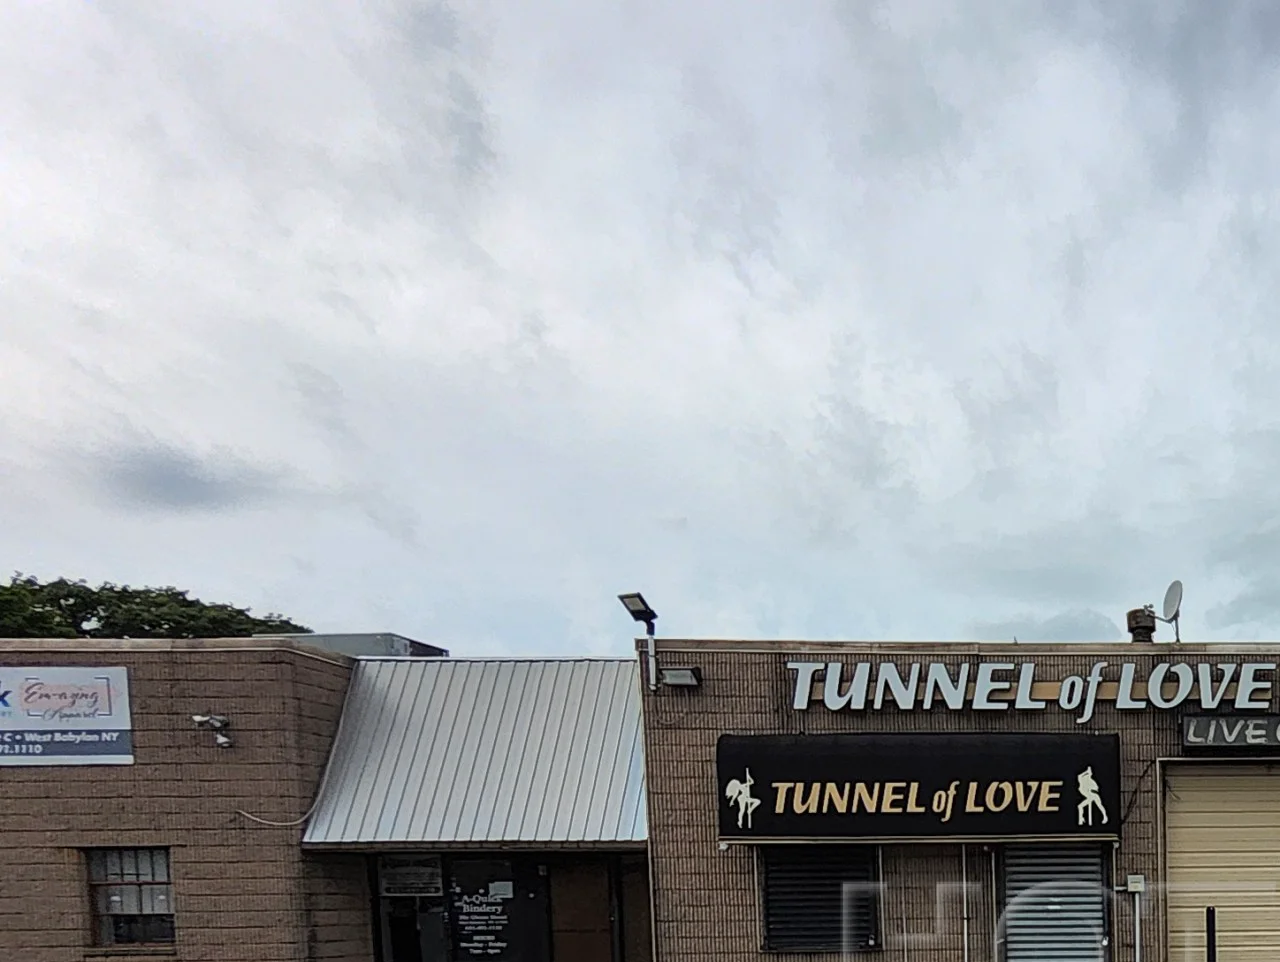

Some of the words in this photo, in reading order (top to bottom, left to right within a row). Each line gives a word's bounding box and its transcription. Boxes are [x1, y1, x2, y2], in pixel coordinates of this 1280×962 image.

[787, 661, 1048, 711] TUNNEL
[1058, 661, 1108, 723] of
[1116, 661, 1277, 710] LOVE
[54, 732, 99, 744] Babylon
[101, 732, 120, 742] NY
[1186, 718, 1269, 744] LIVE
[771, 781, 926, 815] TUNNEL
[932, 779, 960, 822] of
[966, 780, 1063, 814] LOVE
[462, 904, 503, 914] Bindery
